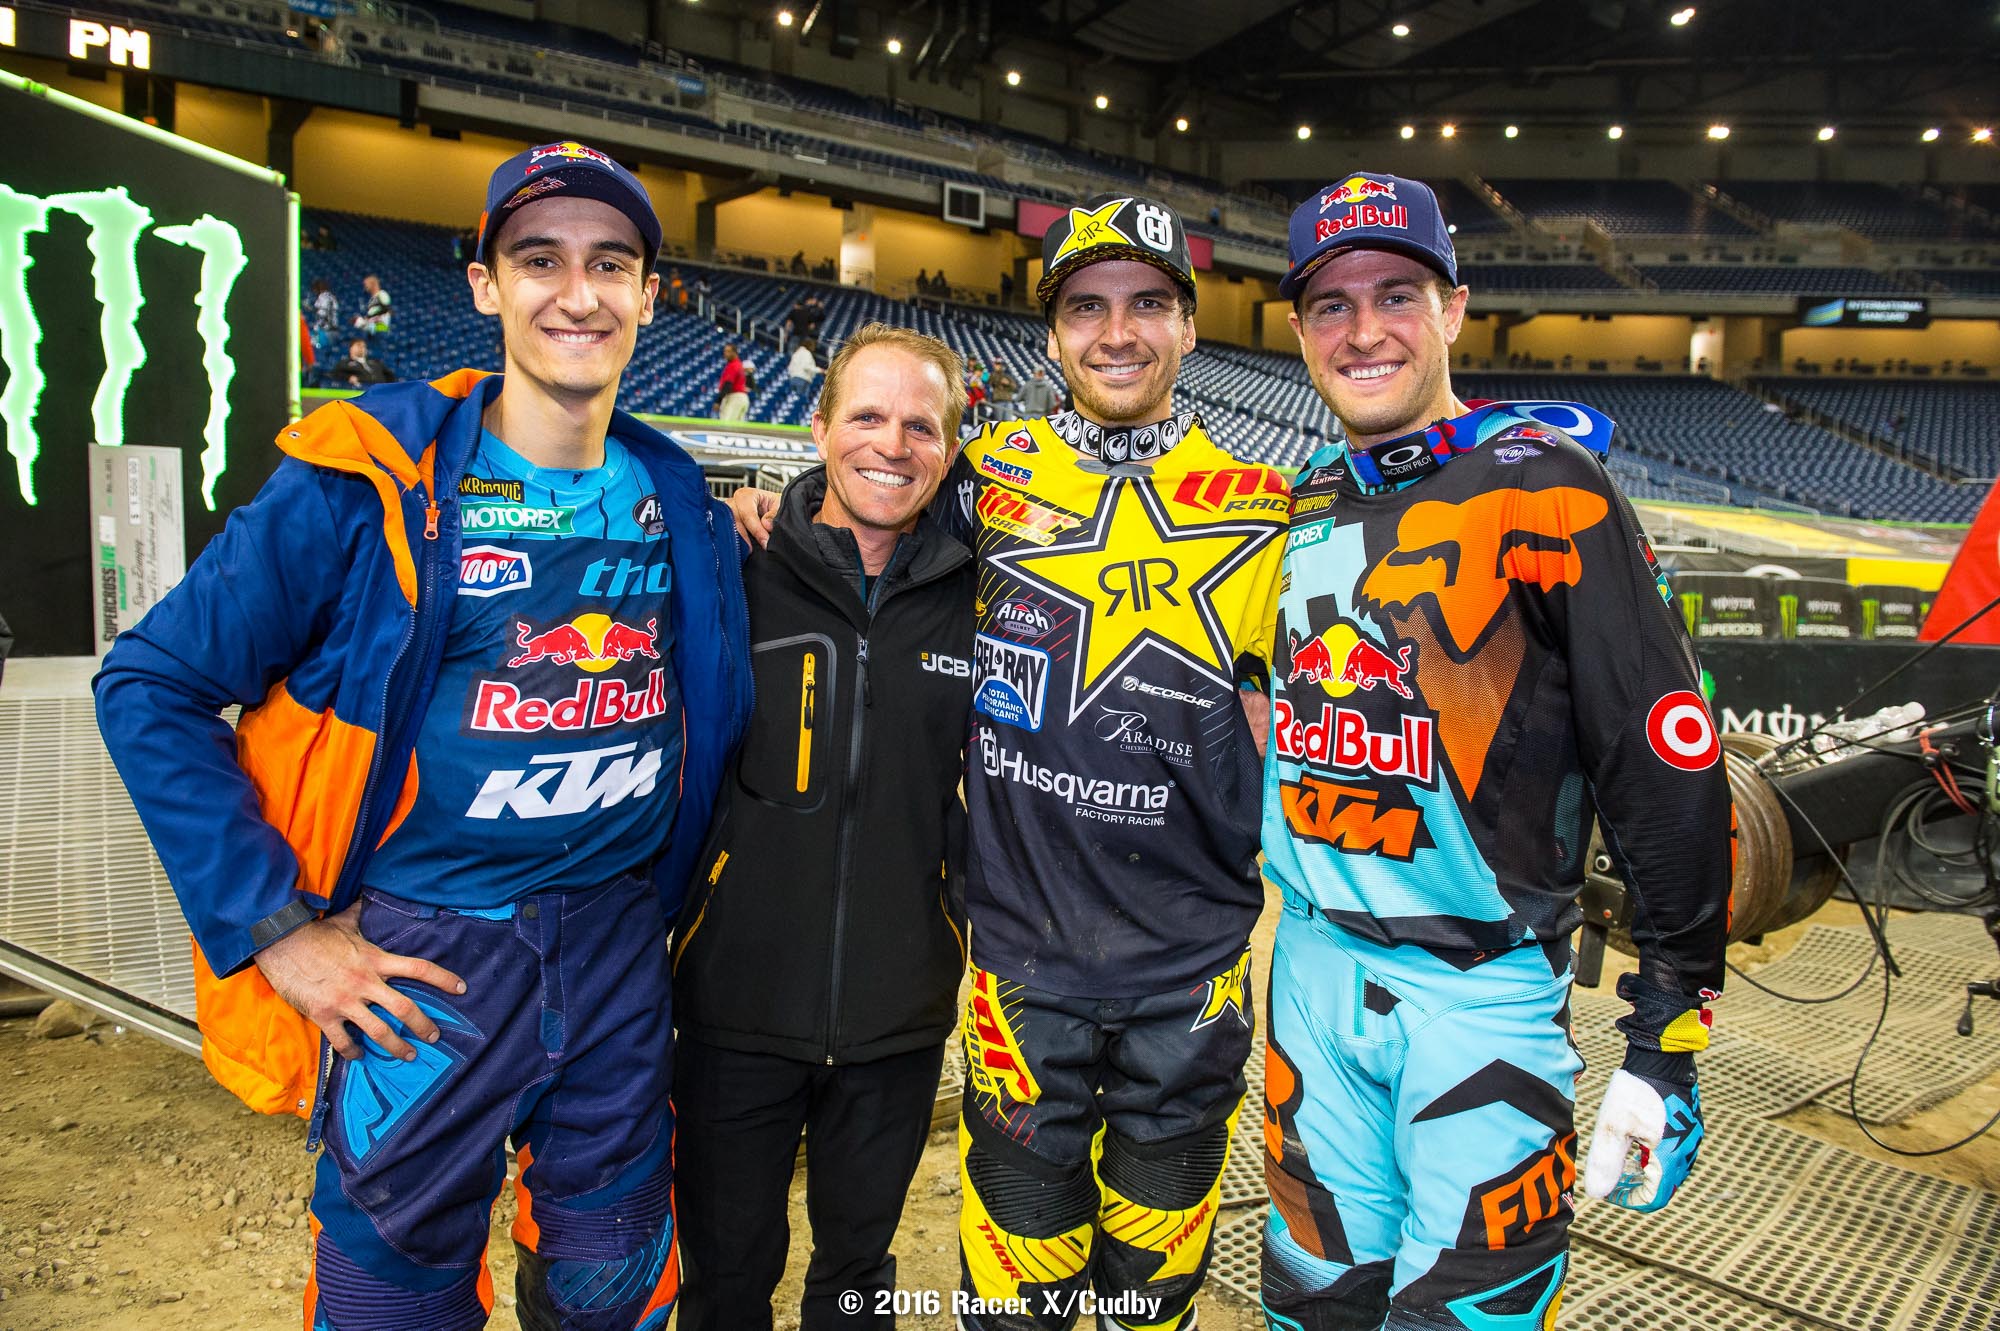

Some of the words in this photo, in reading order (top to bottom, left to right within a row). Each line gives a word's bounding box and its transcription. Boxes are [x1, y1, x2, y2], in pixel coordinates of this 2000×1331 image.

[69, 18, 150, 70] PM
[1315, 205, 1361, 244] Red
[1361, 204, 1408, 230] Bull
[1383, 464, 1413, 476] FACTORY
[1413, 455, 1433, 469] PILOT
[1504, 447, 1523, 458] FIM
[980, 463, 1030, 487] UNLIMITED
[981, 454, 1033, 480] PARTS
[461, 505, 564, 530] MOTOREX
[988, 516, 1053, 543] RACING
[1287, 524, 1328, 549] TOREX
[460, 559, 519, 584] 100%
[997, 602, 1049, 630] Airoh
[921, 652, 970, 677] JCB
[470, 677, 594, 733] Red
[590, 667, 666, 729] Bull
[988, 688, 1009, 700] TOTAL
[1138, 682, 1216, 709] SCOSCHE
[1094, 704, 1193, 758] PARADISE
[1275, 697, 1333, 764] Red
[1332, 707, 1432, 783] Bull
[465, 741, 663, 819] KTM
[1000, 747, 1170, 809] Husqvarna
[1075, 808, 1125, 824] FACTORY
[1127, 815, 1165, 827] RACING
[1280, 776, 1419, 857] KTM
[1164, 1200, 1212, 1256] THOR
[977, 1219, 1024, 1283] THOR
